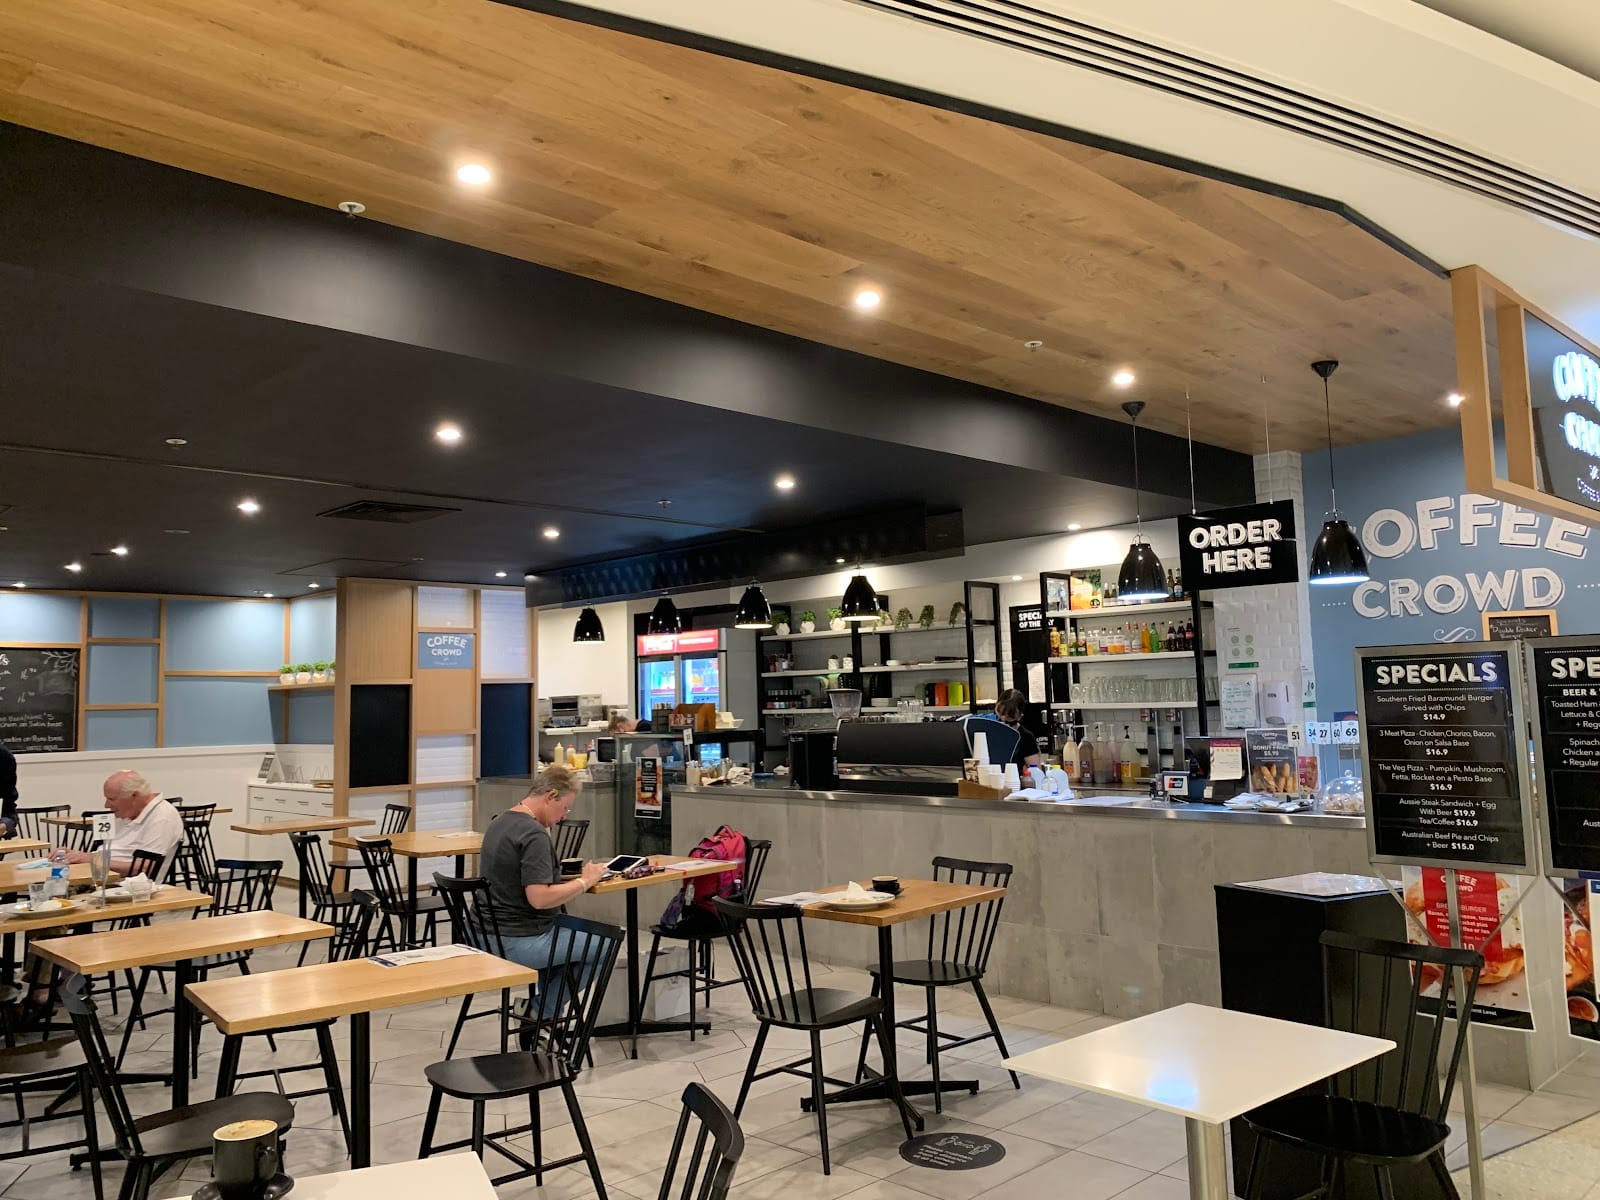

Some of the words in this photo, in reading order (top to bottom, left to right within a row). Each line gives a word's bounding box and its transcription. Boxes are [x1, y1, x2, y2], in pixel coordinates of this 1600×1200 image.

[1361, 493, 1591, 559] OFFEE
[1189, 518, 1282, 549] ORDER
[1202, 546, 1272, 574] HERE
[1352, 568, 1565, 620] CROWD
[1018, 611, 1042, 621] SPECI
[427, 635, 468, 648] COFFEE
[431, 648, 462, 656] CROWD
[1376, 661, 1498, 685] SPECIALS
[1562, 688, 1587, 696] BEER
[1589, 688, 1597, 696] &
[1377, 695, 1407, 703] Southern
[1427, 694, 1466, 702] Baramundi
[1467, 694, 1493, 703] Burger
[1444, 704, 1466, 712] Chips
[1551, 700, 1579, 708] Toasted
[1580, 700, 1598, 708] Ham
[1560, 710, 1587, 718] Lettuce
[1588, 710, 1595, 718] &
[1291, 731, 1300, 740] 51
[1308, 728, 1316, 737] 34
[1319, 729, 1328, 738] 27
[1345, 727, 1357, 737] 69
[1473, 730, 1496, 738] Bacon,
[1453, 739, 1470, 747] Base
[1426, 748, 1448, 756] $16.9
[1562, 748, 1593, 756] Chicken
[1569, 758, 1599, 768] Regular
[1378, 763, 1391, 771] The
[1391, 764, 1406, 773] Veg
[1406, 764, 1424, 772] Pizza
[1429, 765, 1462, 773] Pumpkin,
[1463, 765, 1506, 774] Mushroom,
[1411, 773, 1435, 781] Rocket
[1453, 774, 1473, 782] Pesto
[1429, 783, 1453, 791] $16.9
[1440, 799, 1474, 807] Sandwich
[1481, 800, 1497, 810] Egg
[1436, 808, 1452, 816] Beer
[1453, 809, 1476, 817] $19.9
[1418, 816, 1455, 826] Tea/Coffee
[1455, 819, 1478, 827] $16.9
[98, 822, 111, 832] 29
[1401, 830, 1434, 839] Australian
[1463, 833, 1477, 841] and
[1478, 834, 1499, 843] Chips
[1432, 841, 1448, 849] Beer
[1451, 842, 1475, 851] $15.0
